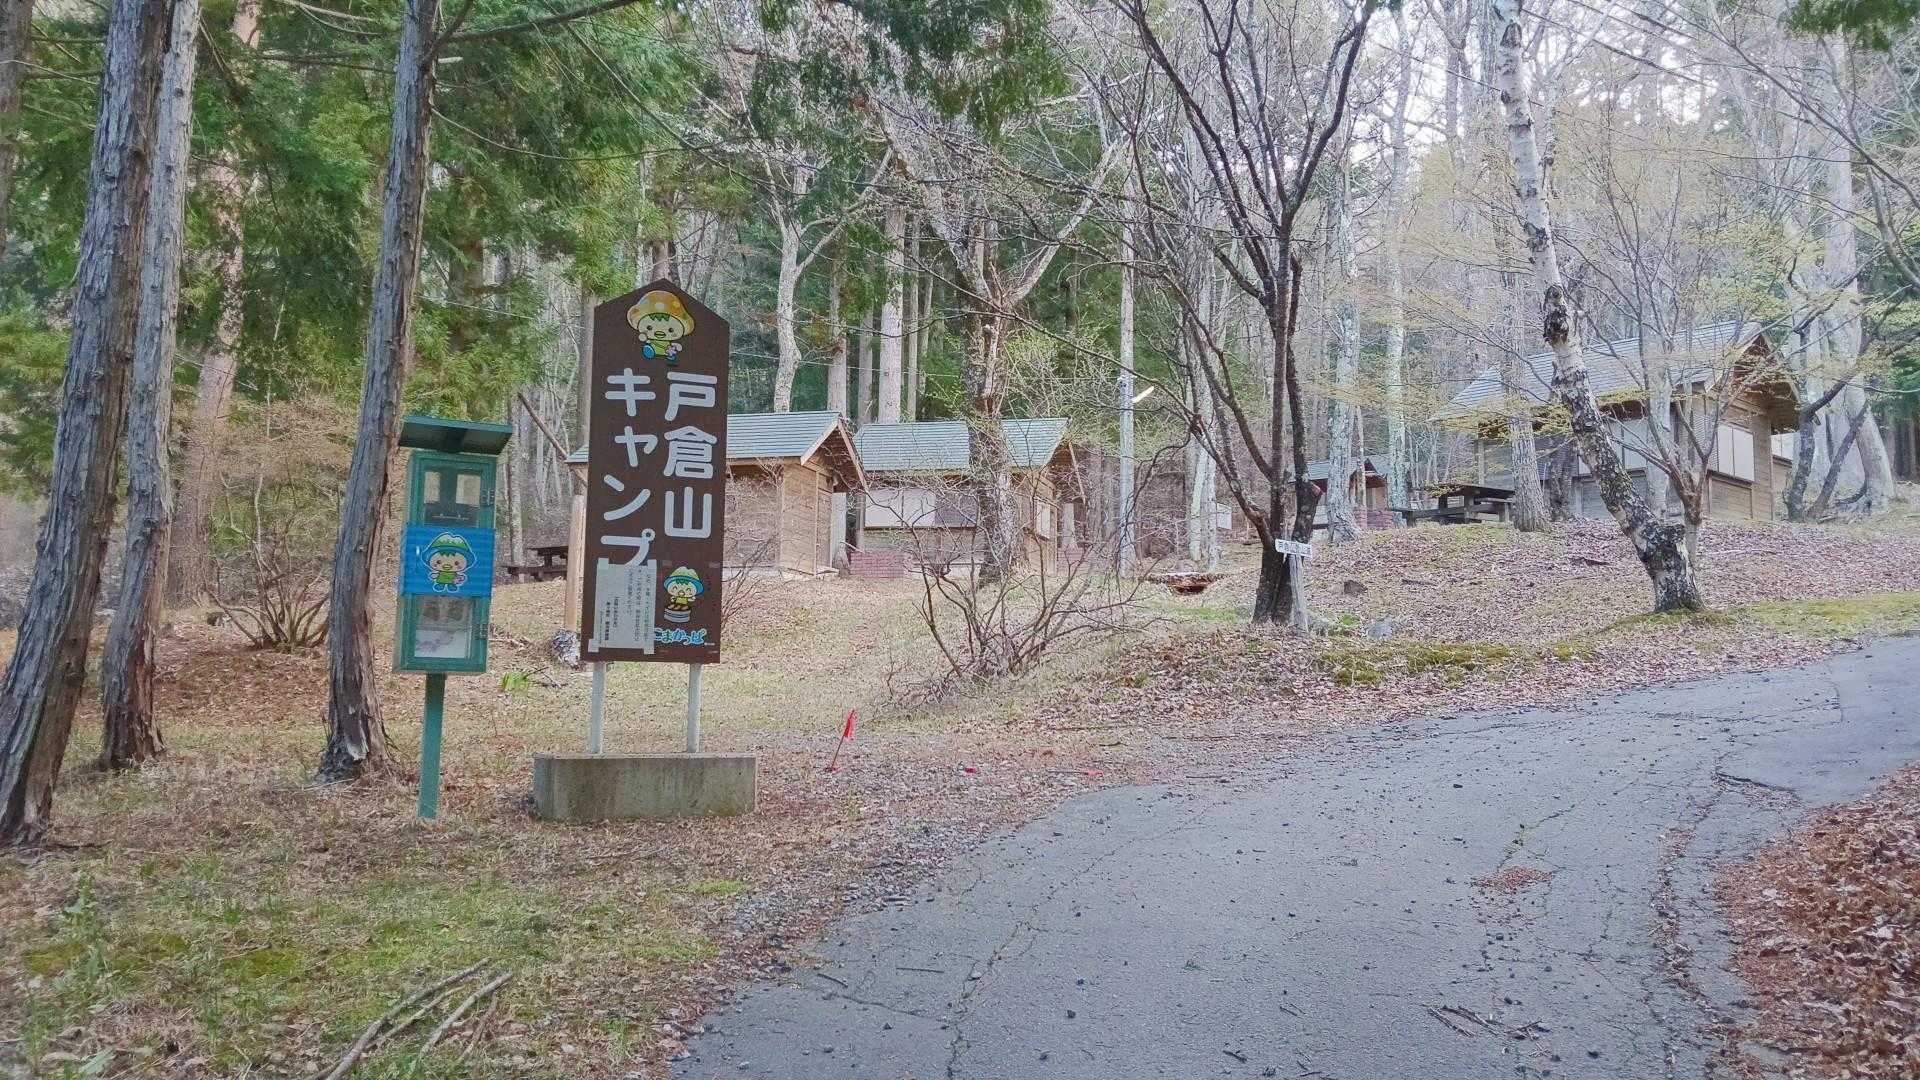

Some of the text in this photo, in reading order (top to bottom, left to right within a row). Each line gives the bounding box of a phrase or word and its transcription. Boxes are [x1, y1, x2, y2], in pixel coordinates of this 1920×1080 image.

[600, 367, 657, 567] キャンプ
[664, 371, 718, 539] 戸倉山
